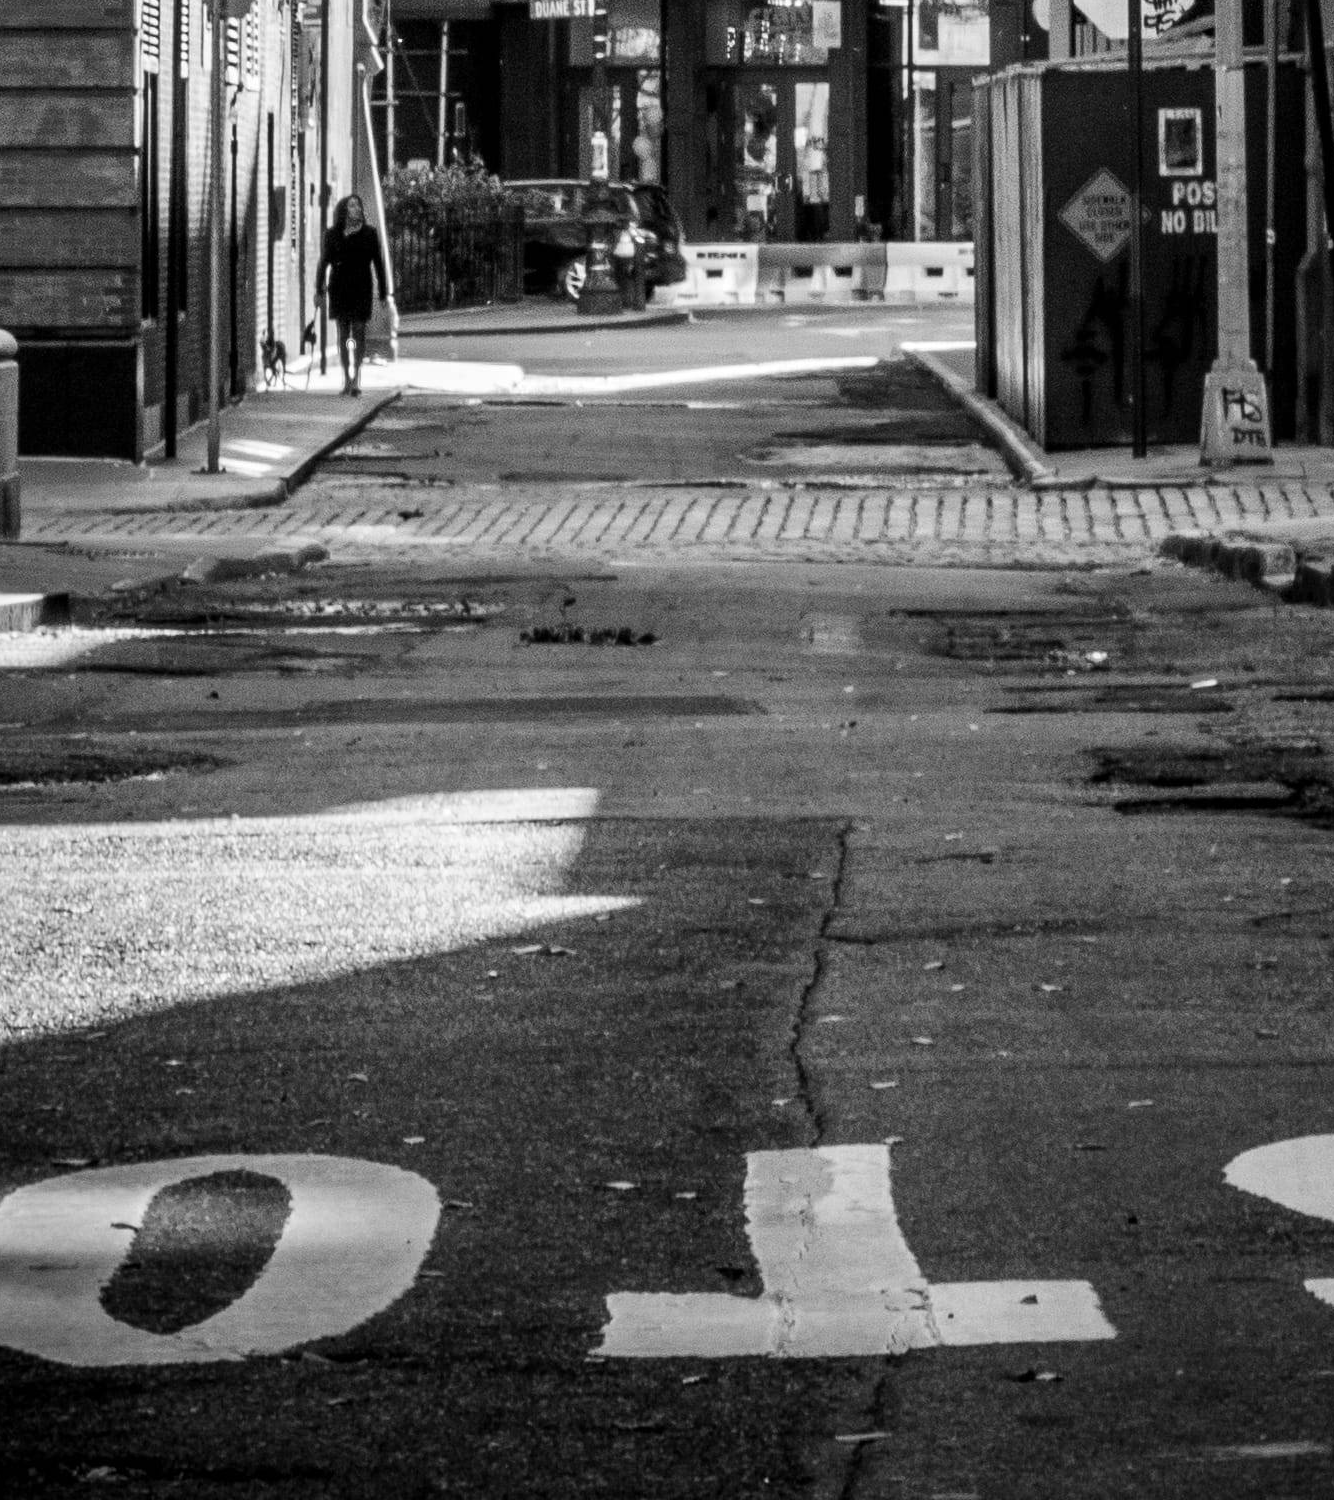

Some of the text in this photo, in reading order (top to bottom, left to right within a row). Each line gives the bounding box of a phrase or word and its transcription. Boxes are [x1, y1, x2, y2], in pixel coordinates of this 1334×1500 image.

[534, 0, 587, 19] DUANE ST
[1171, 180, 1217, 206] POS
[1160, 208, 1218, 235] NO BIL
